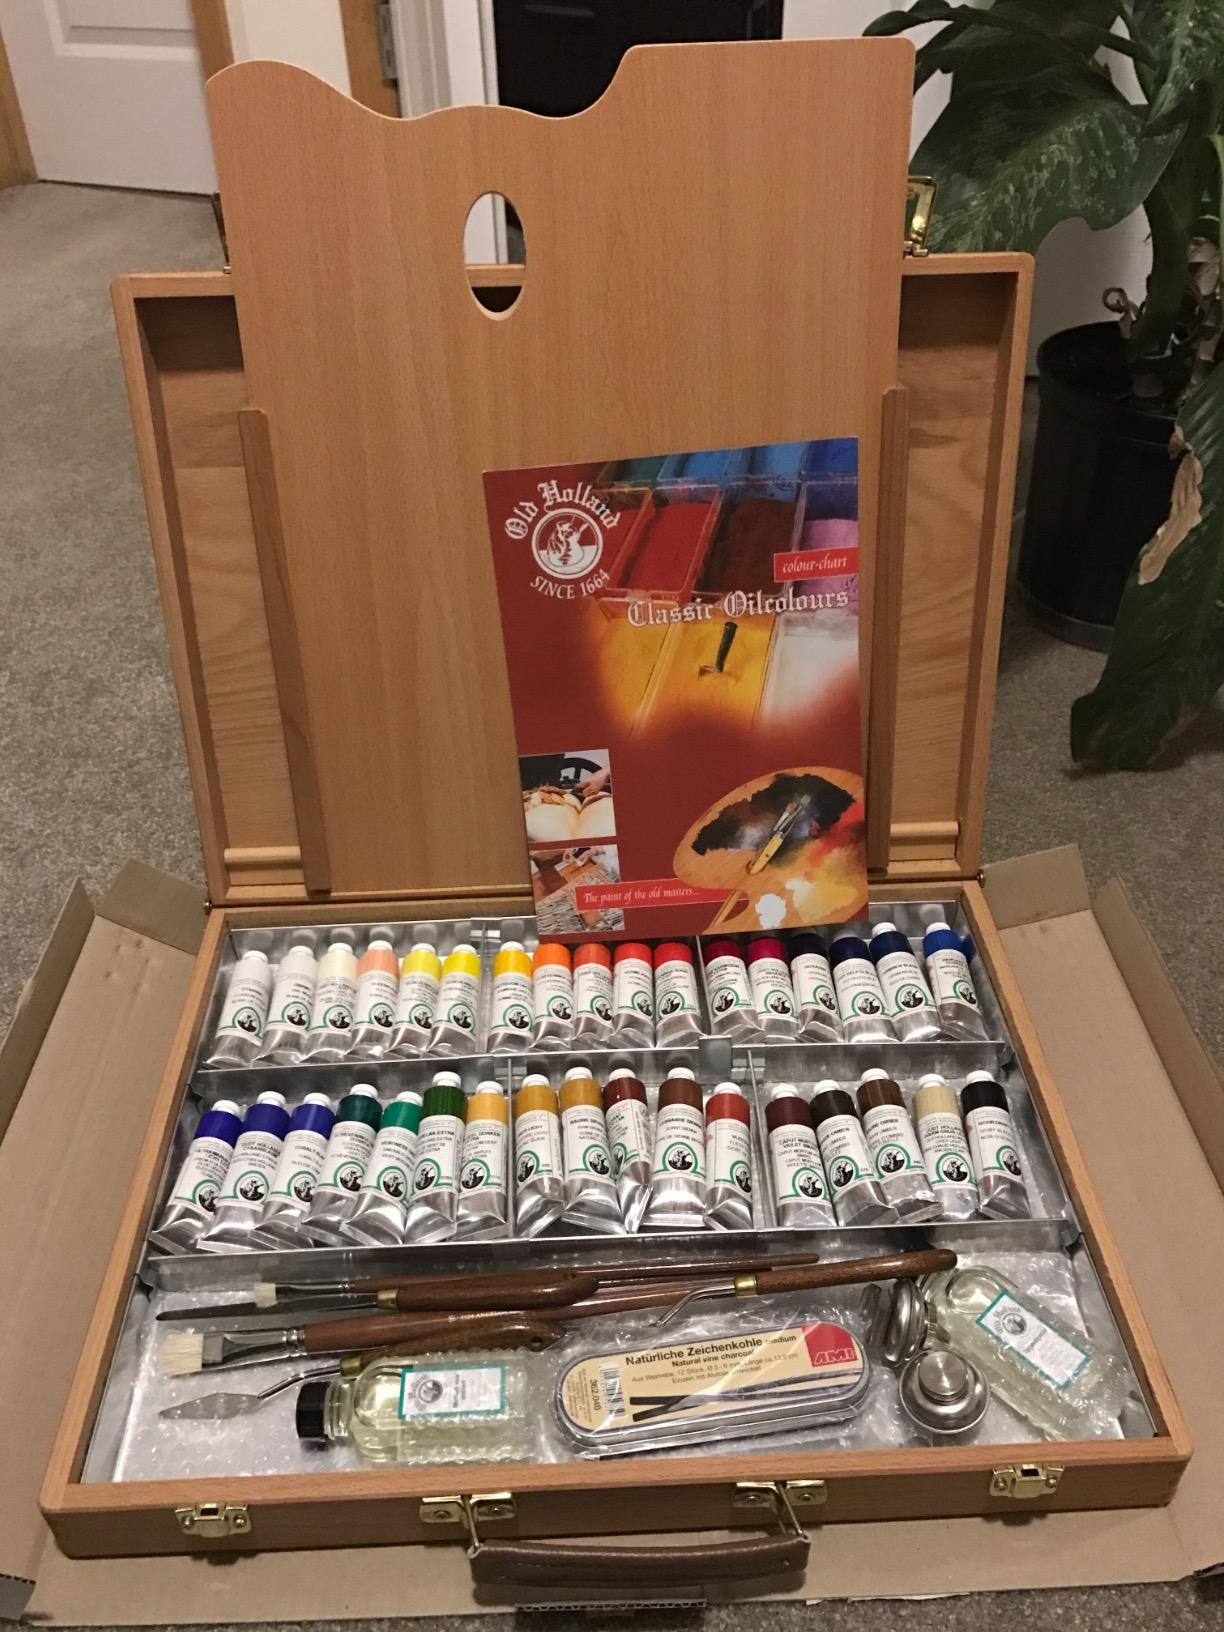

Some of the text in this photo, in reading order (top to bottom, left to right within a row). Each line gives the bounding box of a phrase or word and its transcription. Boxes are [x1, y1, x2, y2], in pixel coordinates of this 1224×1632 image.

[504, 480, 621, 540] Old Holland
[782, 553, 848, 575] colour-chart
[530, 569, 610, 599] SINCE 1664
[627, 587, 849, 627] Classic Oilcolours
[584, 891, 598, 903] The
[599, 892, 622, 906] paint
[624, 890, 632, 905] of
[634, 888, 646, 900] the
[648, 886, 662, 898] old
[626, 1350, 684, 1366] Natürliche
[687, 1337, 763, 1357] Zeichenkohle
[672, 1357, 701, 1368] Natural
[702, 1354, 719, 1363] vine
[813, 1347, 856, 1365] AMI
[589, 1378, 602, 1411] 362.040
